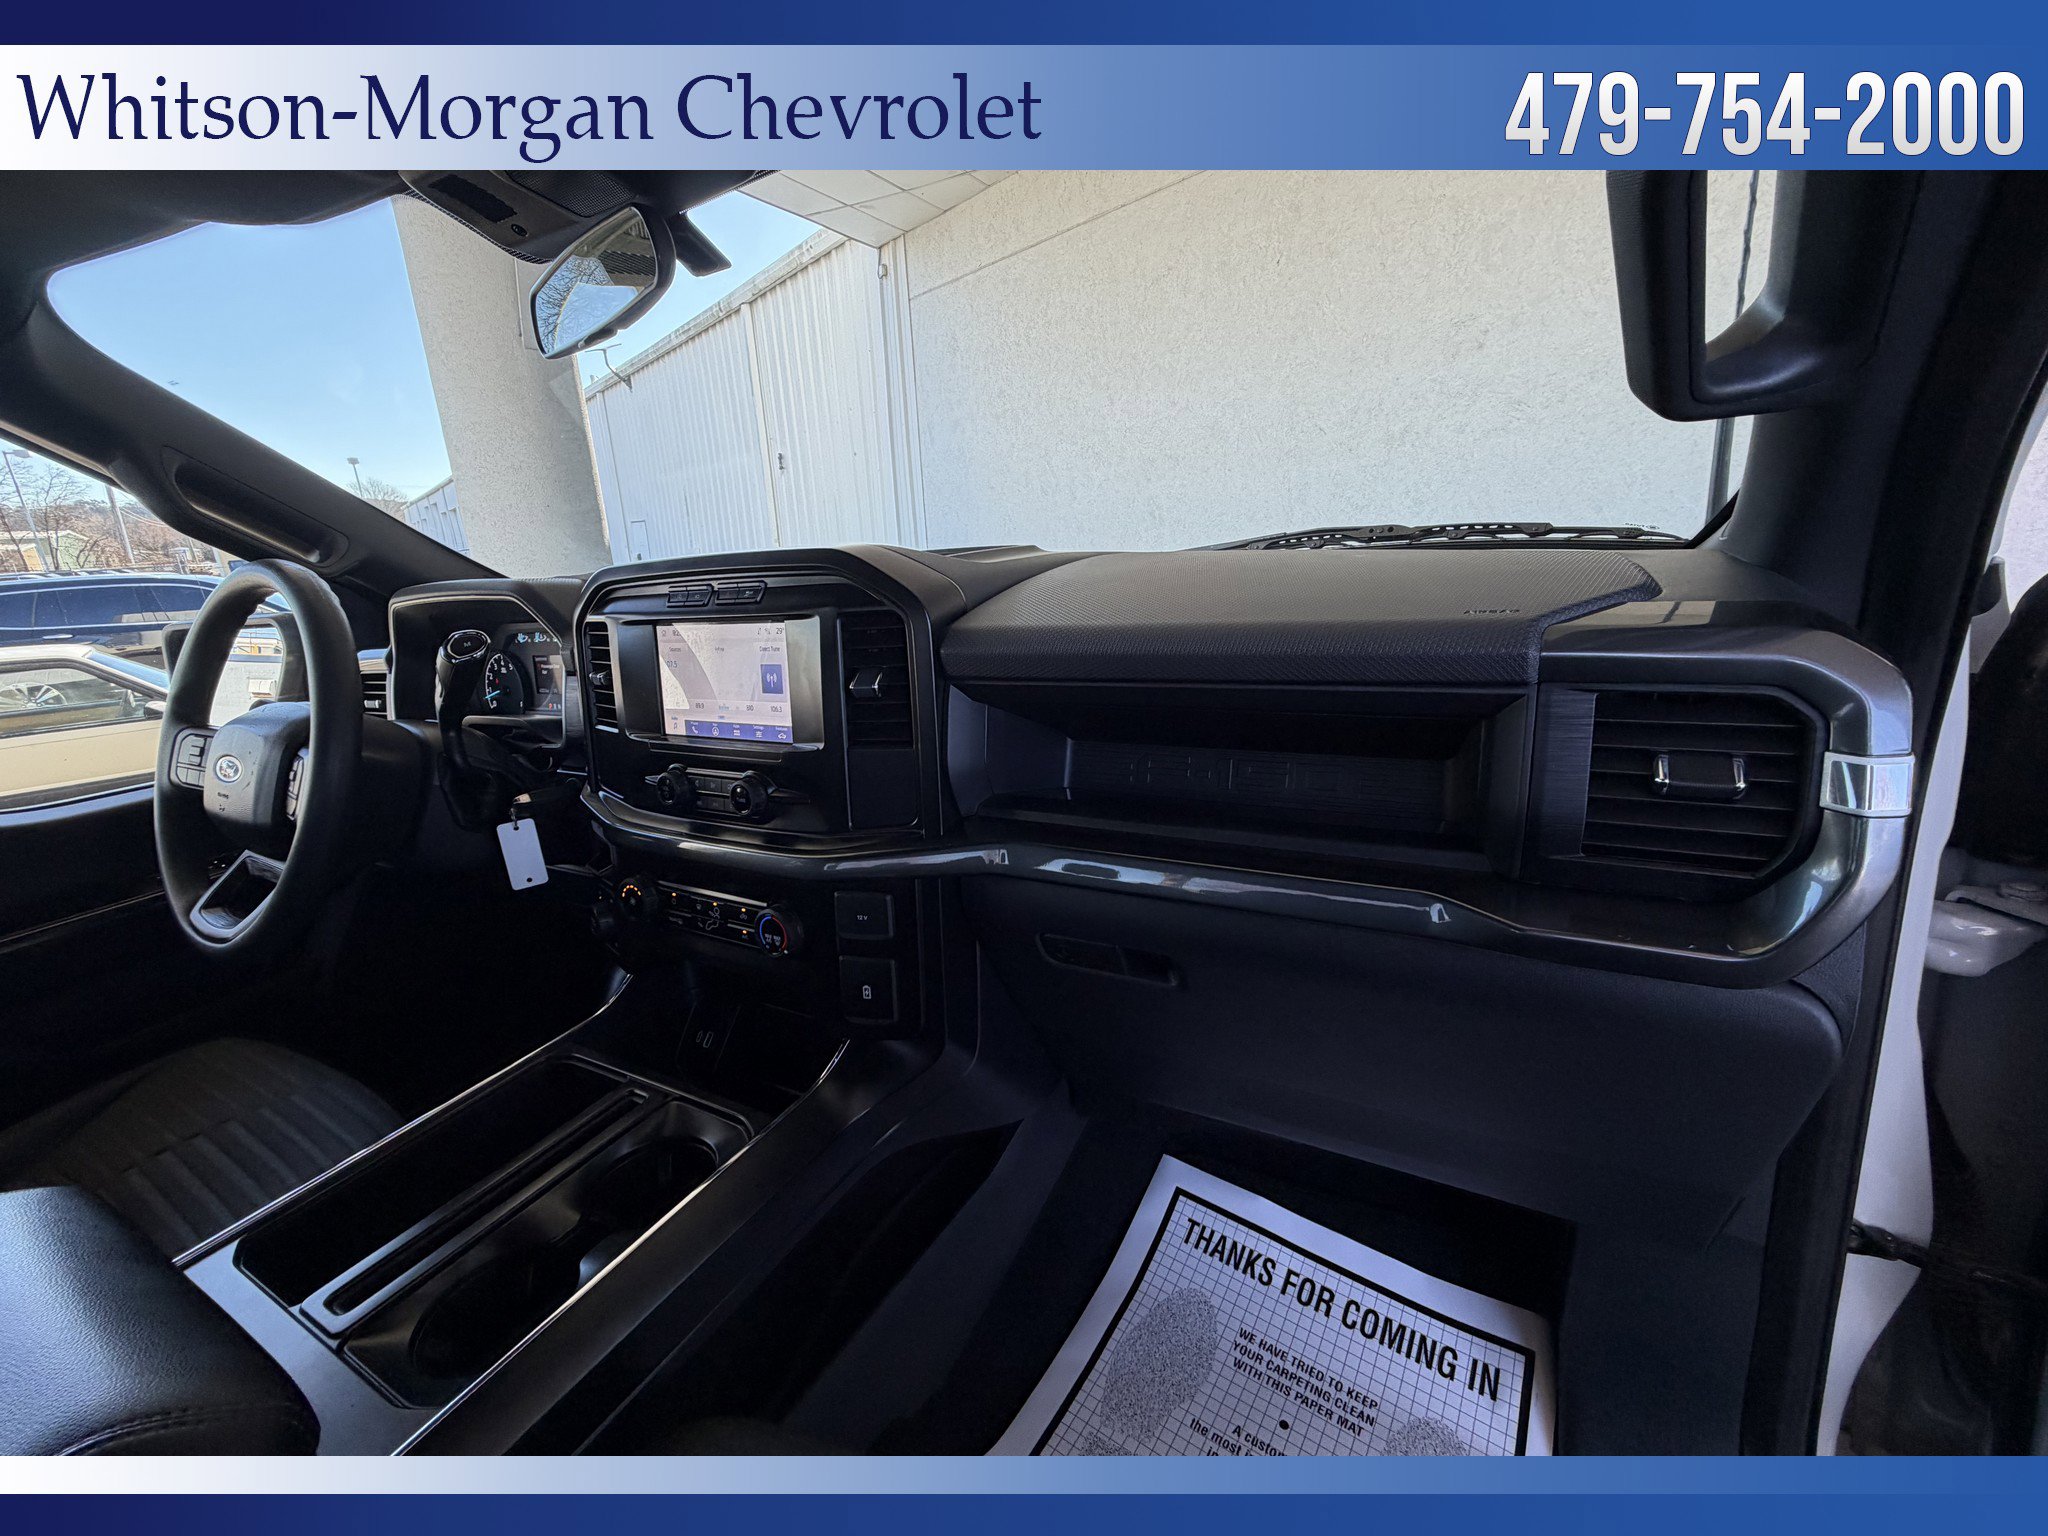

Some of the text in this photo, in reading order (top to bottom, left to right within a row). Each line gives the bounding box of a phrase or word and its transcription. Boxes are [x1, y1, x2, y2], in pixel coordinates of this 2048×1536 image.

[1183, 1217, 1501, 1403] THANKS FOR COMING IN
[1233, 1339, 1376, 1428] YOUR CARPETING CLEAN
[1233, 1356, 1365, 1438] WITH THIS PAPER MAT
[1239, 1327, 1379, 1411] WE HAVE TRIED TO KEEP
[1189, 1418, 1242, 1457] the most
[1231, 1425, 1242, 1437] A
